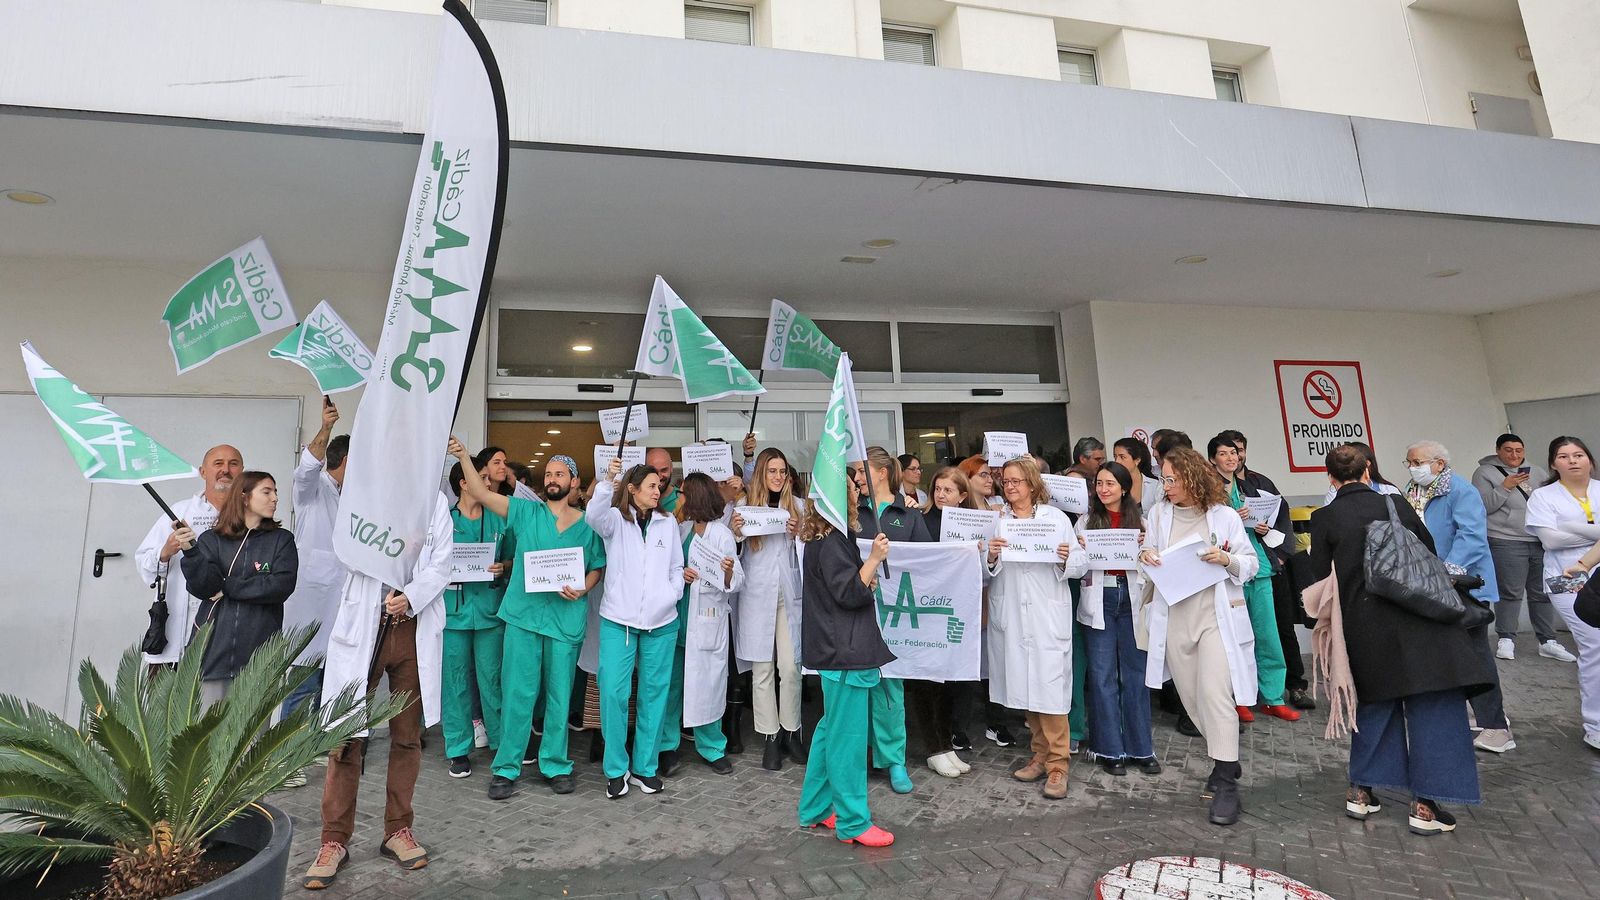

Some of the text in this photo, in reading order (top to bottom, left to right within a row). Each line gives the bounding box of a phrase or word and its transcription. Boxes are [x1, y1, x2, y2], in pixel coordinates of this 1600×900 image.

[769, 308, 791, 363] Cádiz
[789, 324, 840, 359] SMA
[1292, 423, 1363, 438] PROHIBIDO
[1307, 441, 1351, 456] FUM
[946, 530, 964, 541] SMA
[1008, 544, 1054, 552] SMA SMA
[1114, 552, 1134, 561] SMA
[467, 564, 485, 572] SMA
[919, 595, 953, 607] Cádiz
[904, 638, 948, 649] Federación
